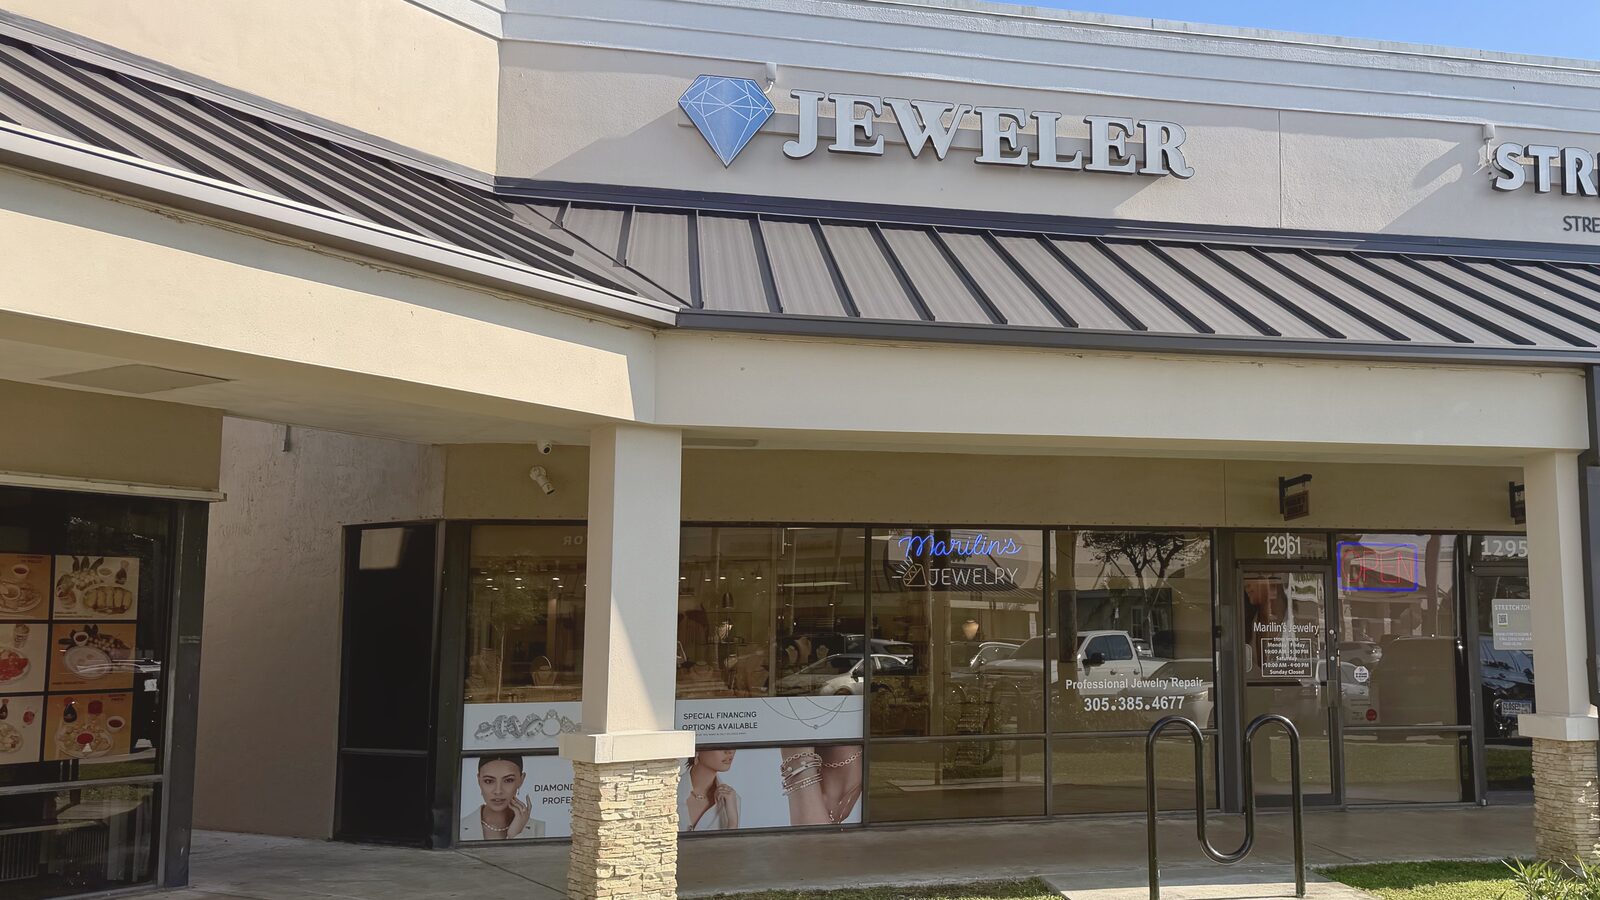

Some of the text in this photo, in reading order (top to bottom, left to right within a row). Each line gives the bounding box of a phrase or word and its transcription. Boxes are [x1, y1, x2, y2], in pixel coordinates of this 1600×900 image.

[783, 88, 1196, 179] JEWELER
[1492, 142, 1600, 197] STR
[1563, 215, 1600, 233] STRE
[898, 533, 1023, 557] Marilin's
[1263, 536, 1301, 555] 12961
[1480, 540, 1529, 558] 1295
[1341, 549, 1414, 583] OPEN
[928, 567, 1018, 586] JEWELRY
[1253, 621, 1320, 635] Marilin's Jewelry
[1065, 676, 1203, 690] Professional Jewelry Repair
[1083, 695, 1185, 712] 305.385.4677
[683, 711, 757, 720] SPECIAL FINANCING
[681, 722, 758, 731] OPTIONS AVAILABLE
